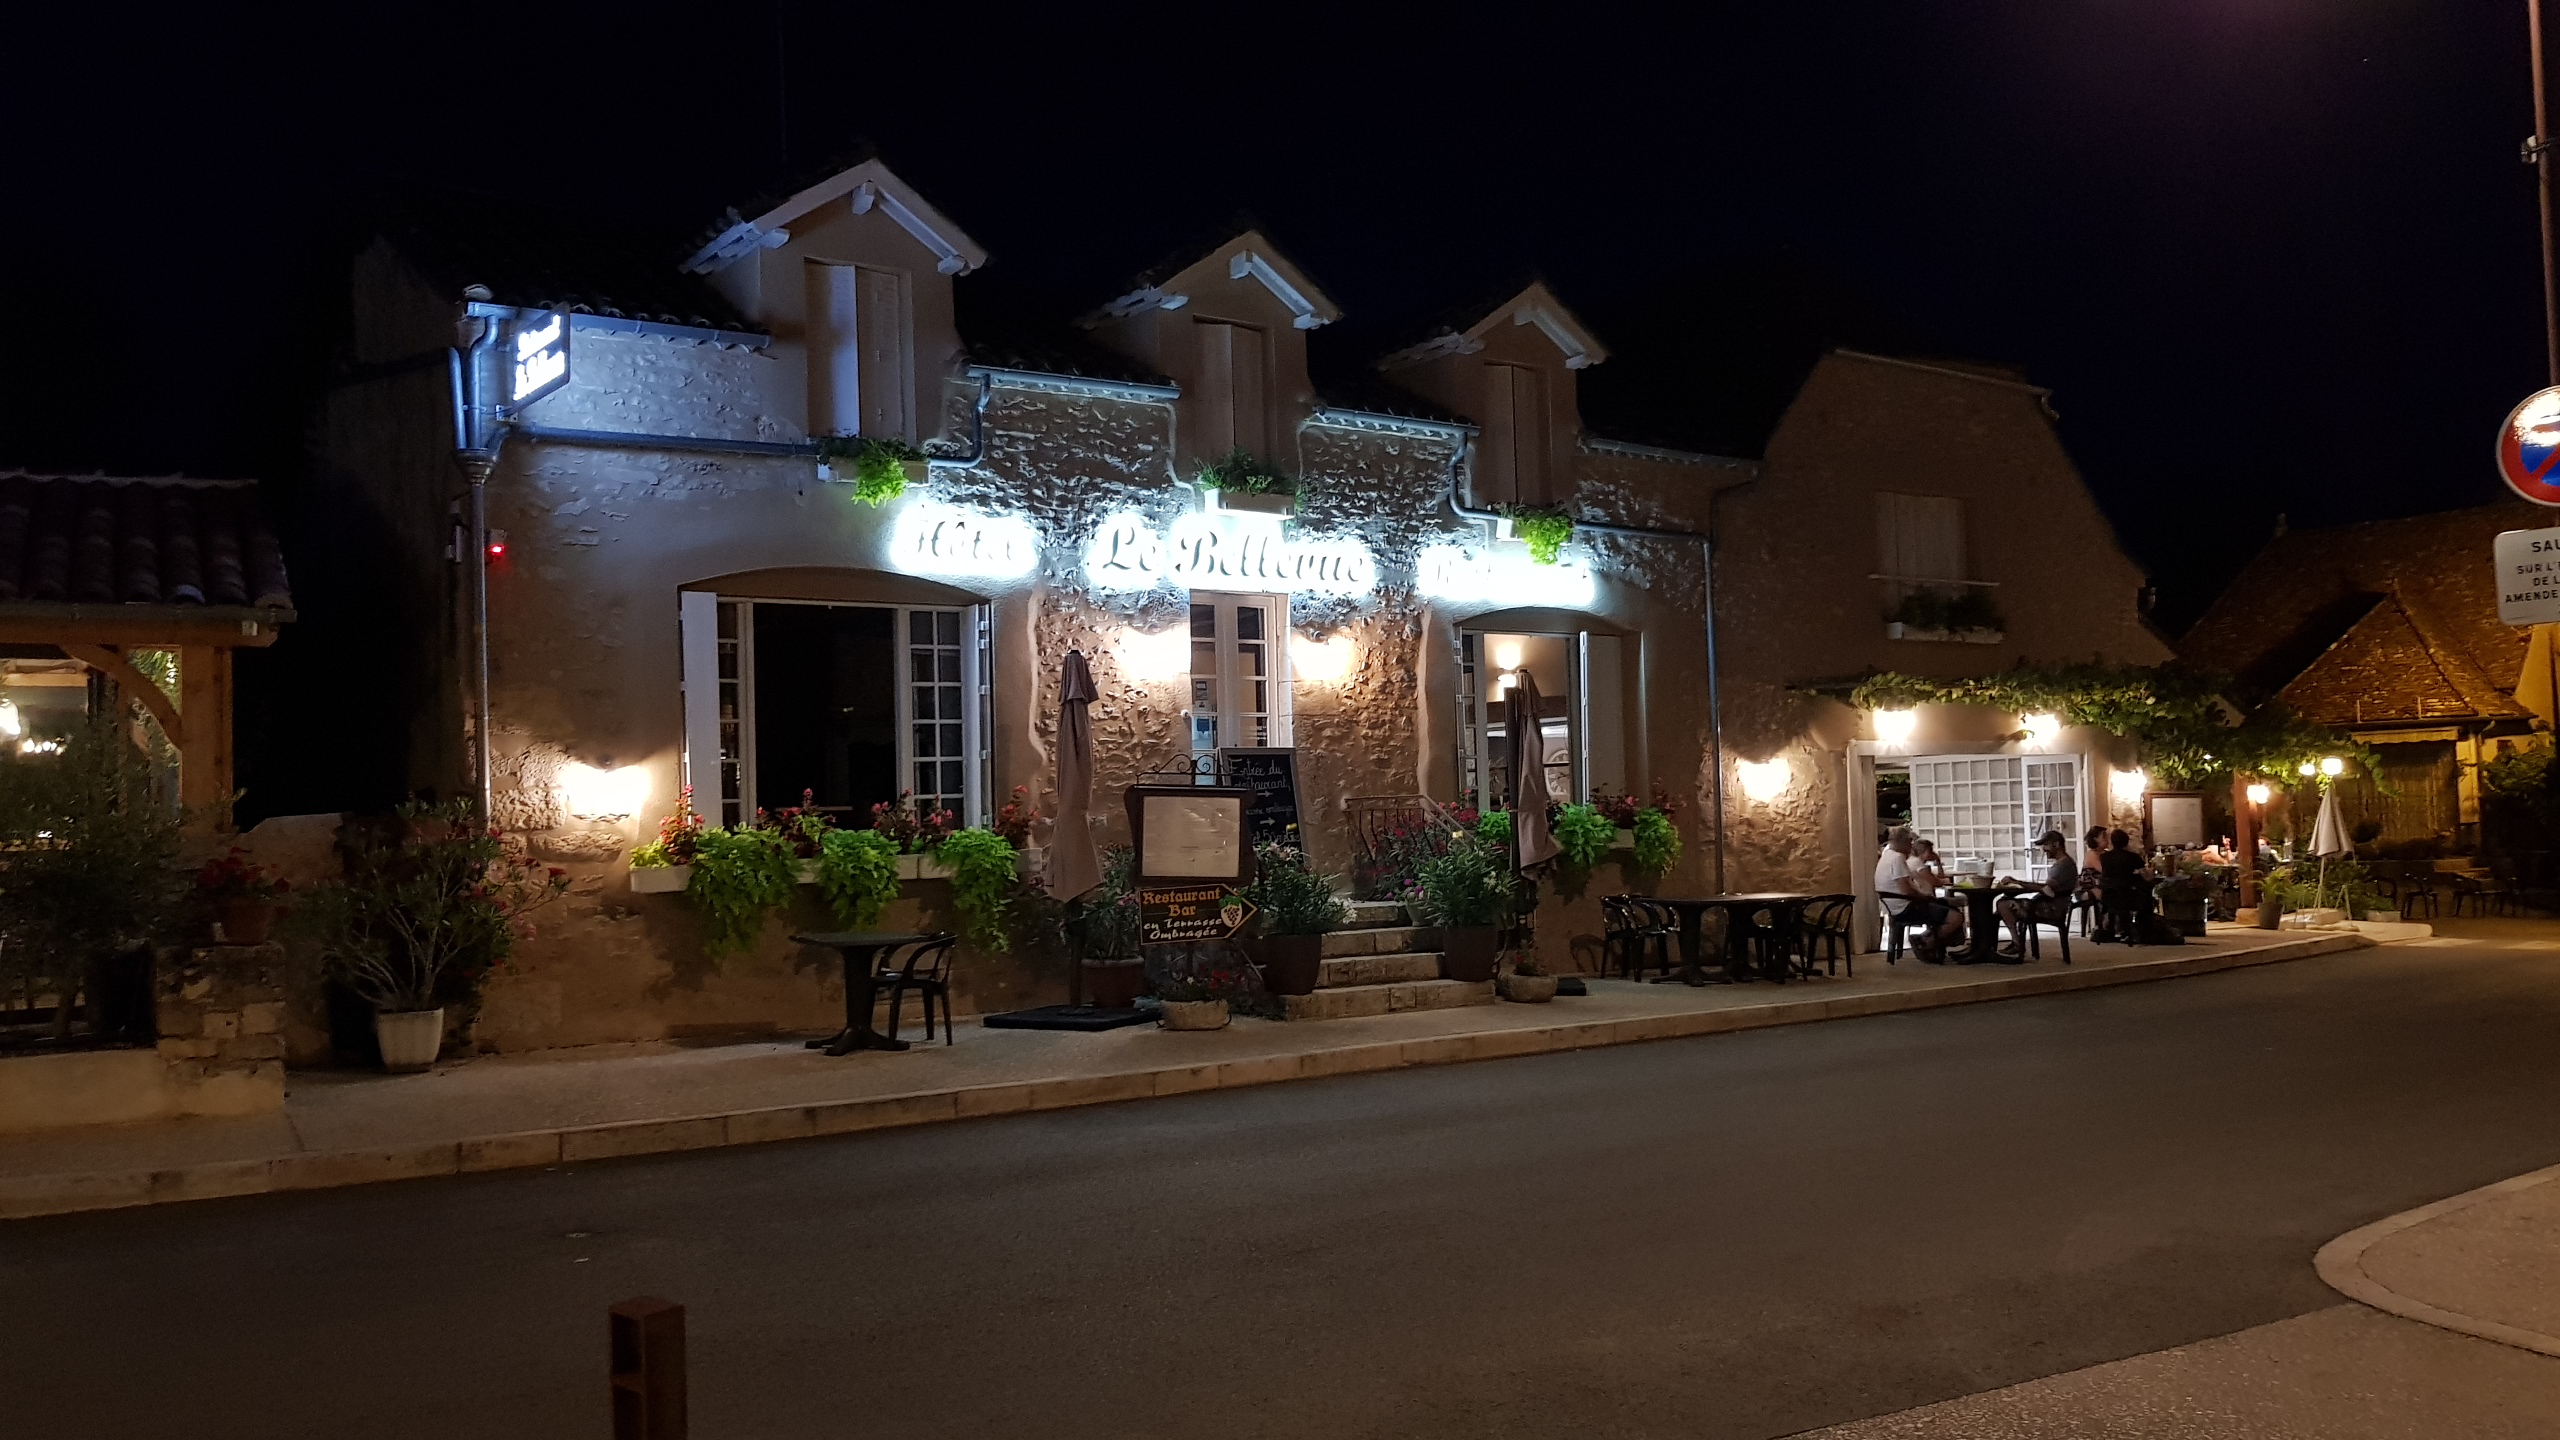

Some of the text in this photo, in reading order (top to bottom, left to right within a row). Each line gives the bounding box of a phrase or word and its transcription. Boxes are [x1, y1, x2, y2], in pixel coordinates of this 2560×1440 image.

[914, 517, 1014, 562] Hôtl
[1102, 525, 1363, 583] Le Bellevue
[2517, 563, 2542, 575] SUR
[2533, 576, 2549, 587] DE
[2505, 589, 2559, 603] AMENDE
[1268, 759, 1283, 775] du
[1142, 887, 1220, 905] Restaurant
[1168, 904, 1197, 917] Bar
[1164, 918, 1222, 929] Terrasse
